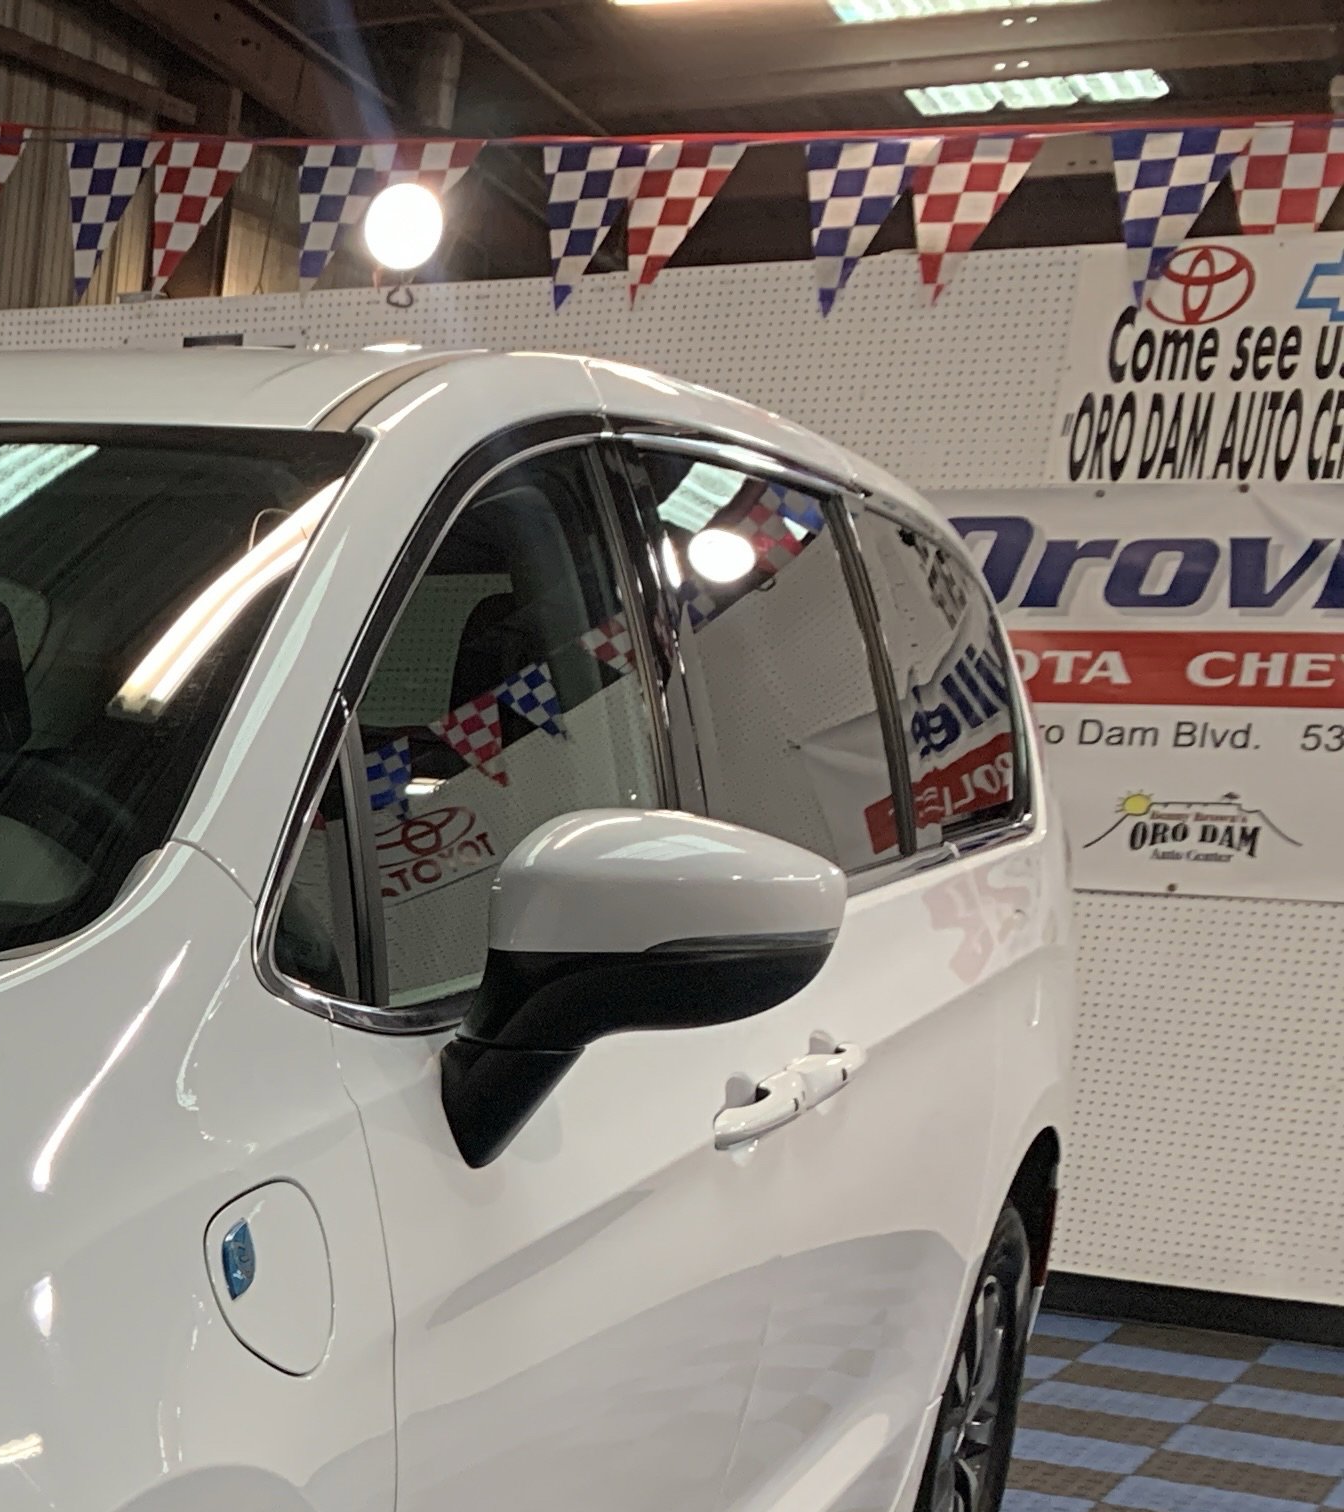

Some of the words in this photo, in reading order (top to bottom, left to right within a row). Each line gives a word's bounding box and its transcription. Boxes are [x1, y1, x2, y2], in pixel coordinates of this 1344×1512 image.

[1109, 305, 1220, 383] Come
[1229, 325, 1303, 381] see
[1315, 325, 1344, 380] u
[1137, 392, 1215, 480] DAM
[1213, 389, 1303, 481] AUTO
[1308, 388, 1344, 481] CE
[1078, 719, 1159, 747] Dam
[1172, 721, 1261, 750] Blvd.
[1129, 821, 1189, 850] ORO
[1197, 824, 1261, 857] DAM
[1150, 848, 1183, 860] Auto
[1186, 849, 1234, 862] Center
